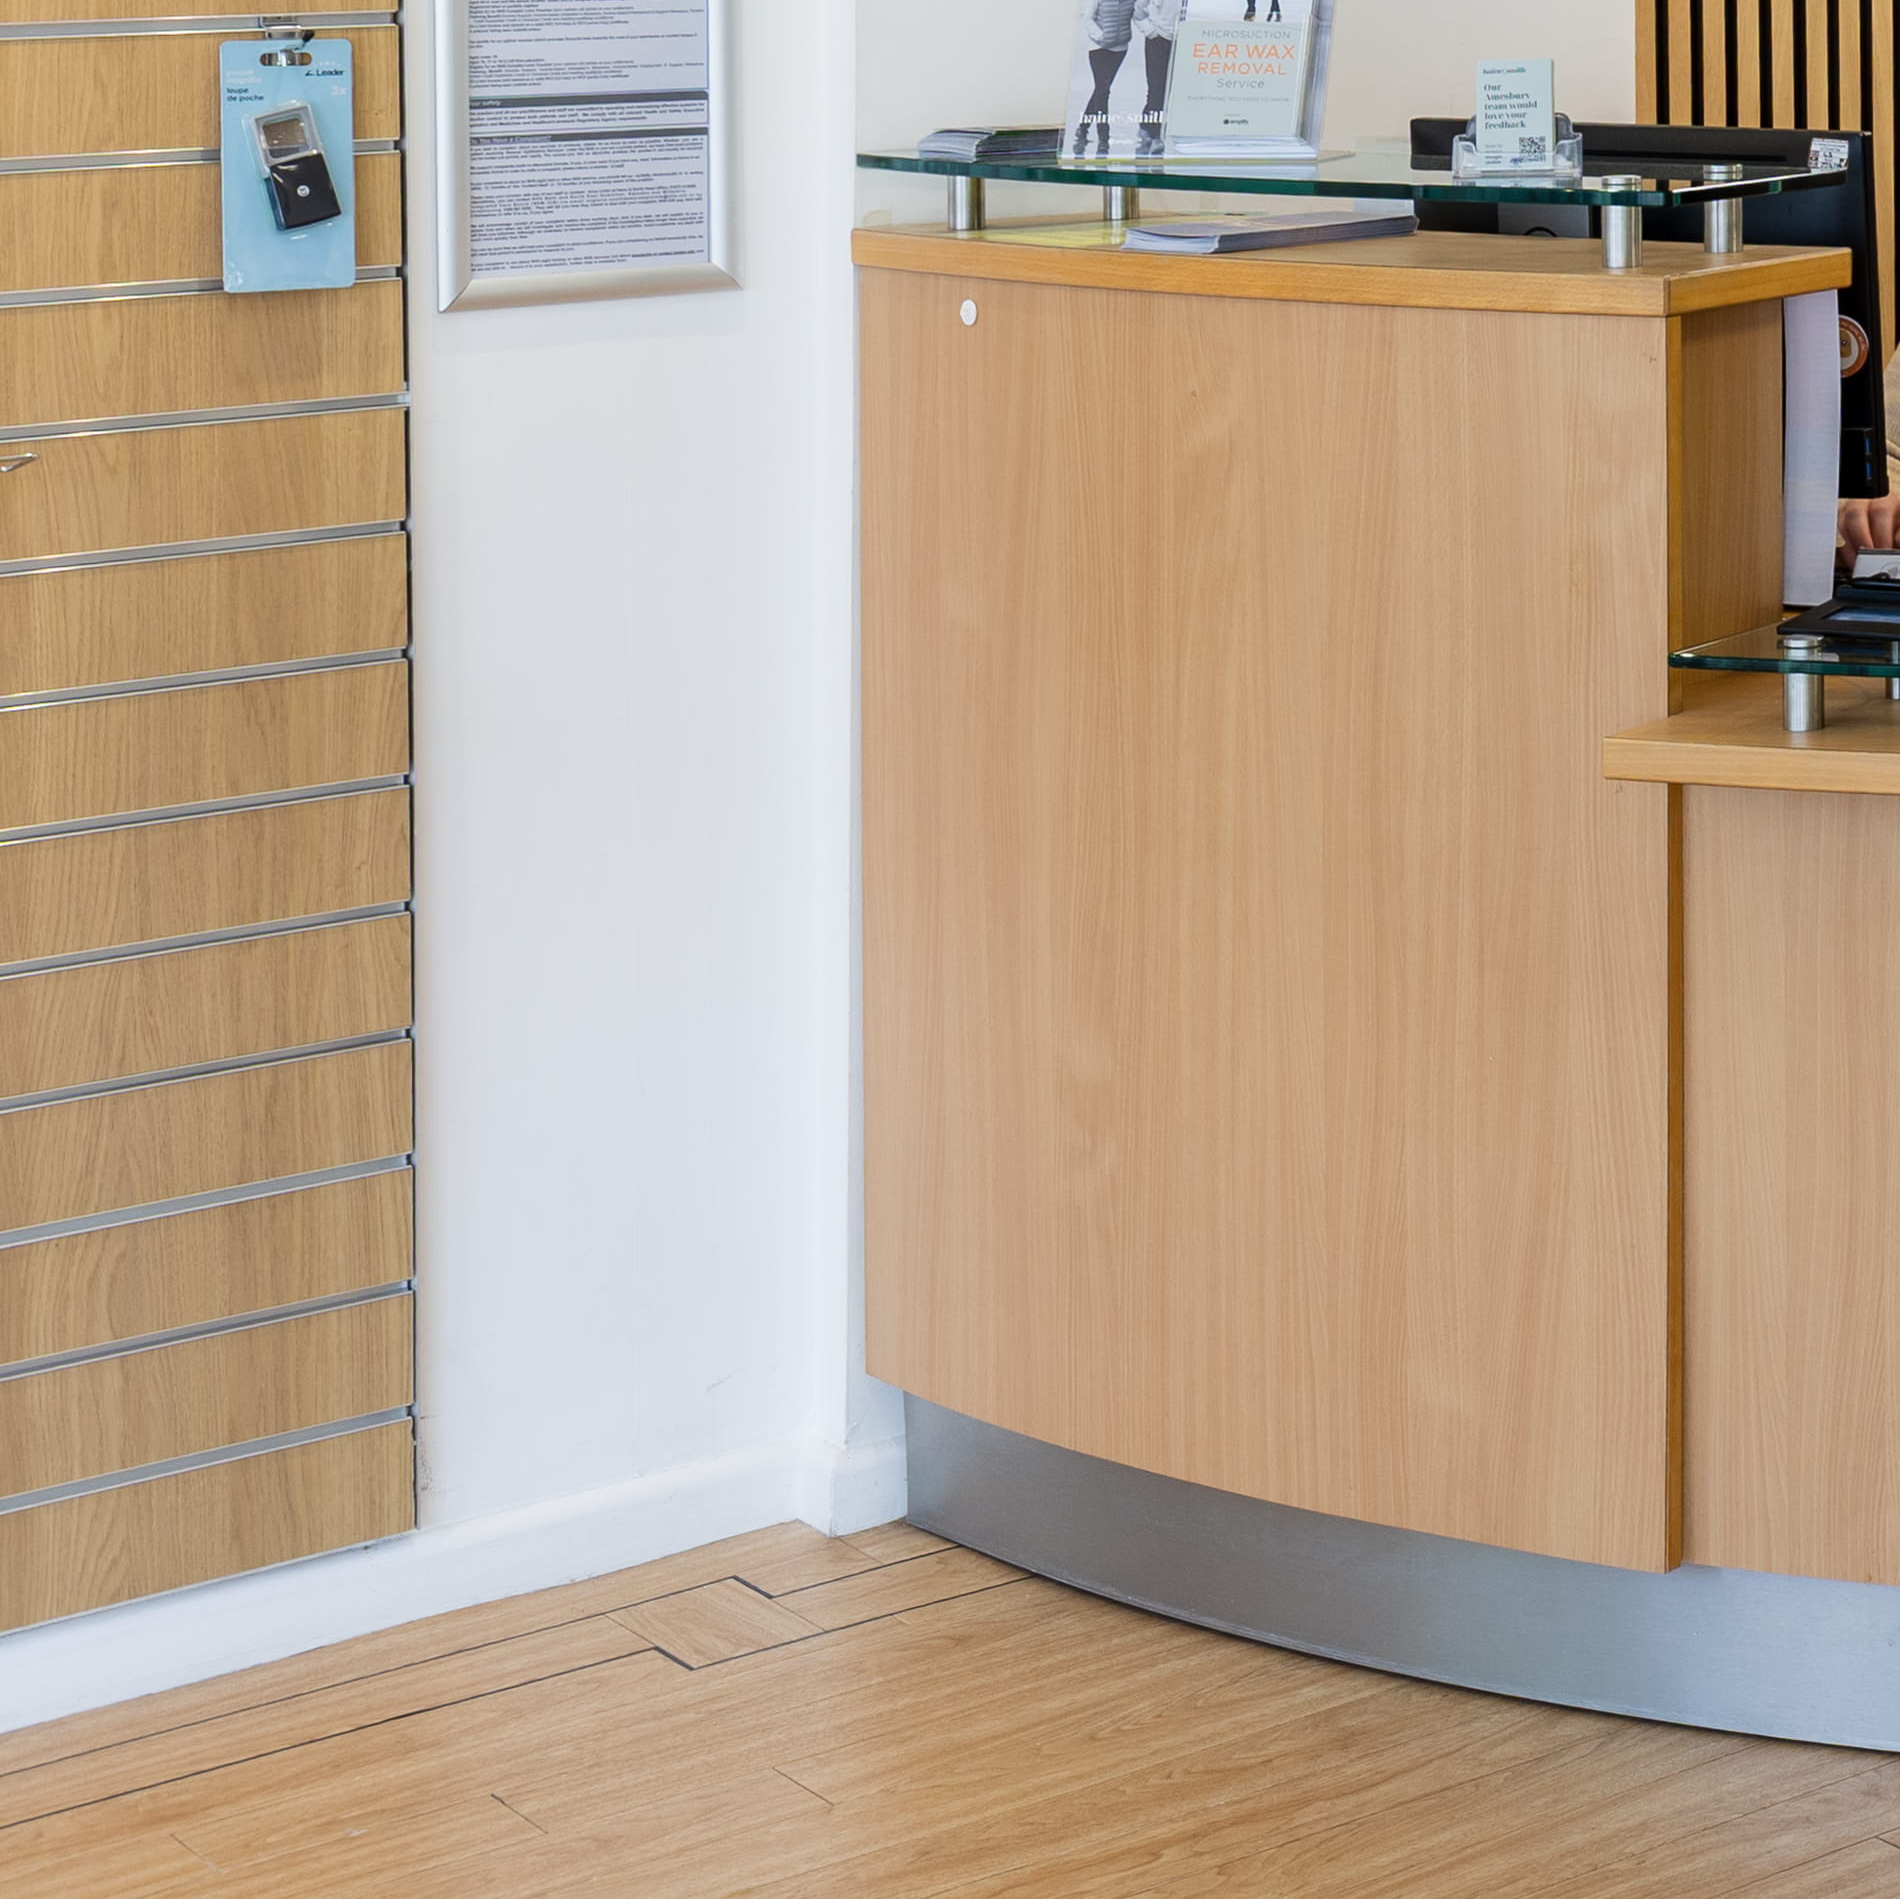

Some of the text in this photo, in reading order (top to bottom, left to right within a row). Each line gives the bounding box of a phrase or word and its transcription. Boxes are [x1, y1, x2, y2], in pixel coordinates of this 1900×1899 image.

[1201, 29, 1291, 39] MICROSUCTION
[1192, 43, 1297, 60] EAR WAX
[316, 69, 345, 77] Leader
[1197, 61, 1287, 76] REMOVAL
[1216, 77, 1265, 89] Service
[1485, 111, 1504, 120] love
[1485, 120, 1527, 130] feedback
